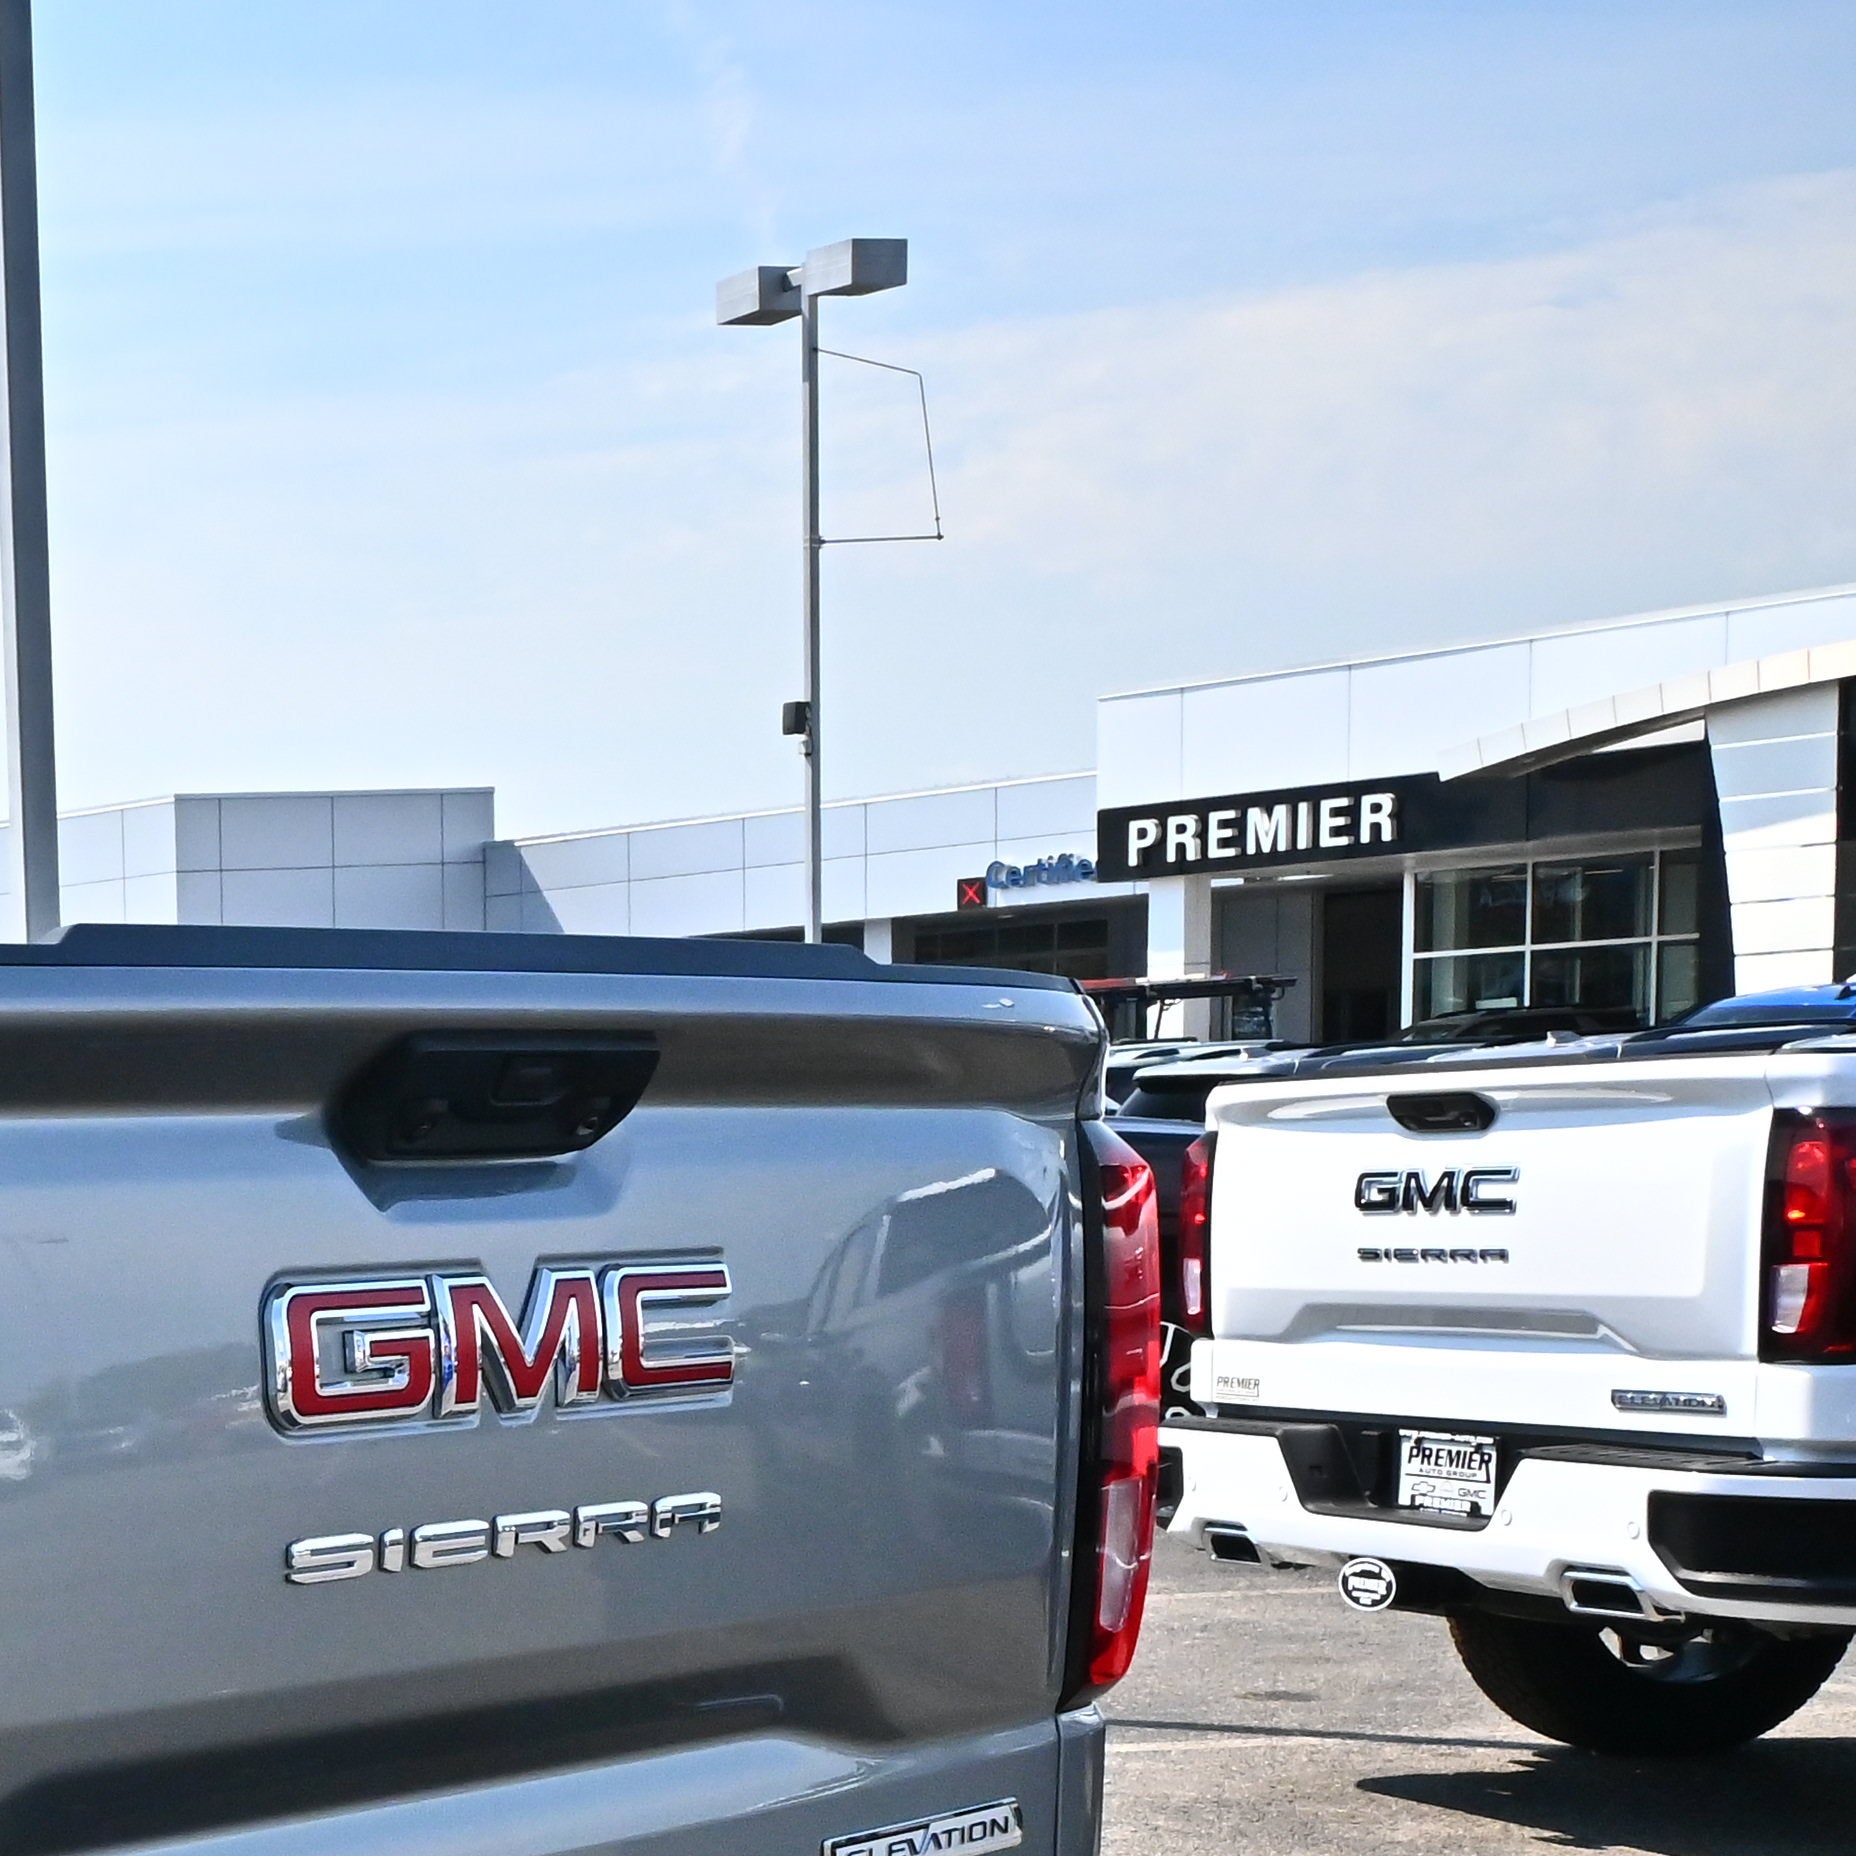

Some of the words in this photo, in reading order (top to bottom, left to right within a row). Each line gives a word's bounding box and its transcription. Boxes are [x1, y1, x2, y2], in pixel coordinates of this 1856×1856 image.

[1128, 792, 1396, 867] PREMIER
[986, 853, 1097, 889] Certifie
[1354, 1166, 1520, 1215] GMC
[1357, 1247, 1509, 1264] SIERRA
[263, 1258, 734, 1428] GMC
[1216, 1376, 1260, 1392] PREMIER
[1408, 1446, 1492, 1474] PREMIER
[1419, 1467, 1444, 1476] AUTO
[1446, 1470, 1478, 1478] GROUP
[1458, 1487, 1487, 1499] GMC
[286, 1491, 722, 1586] SIERRA
